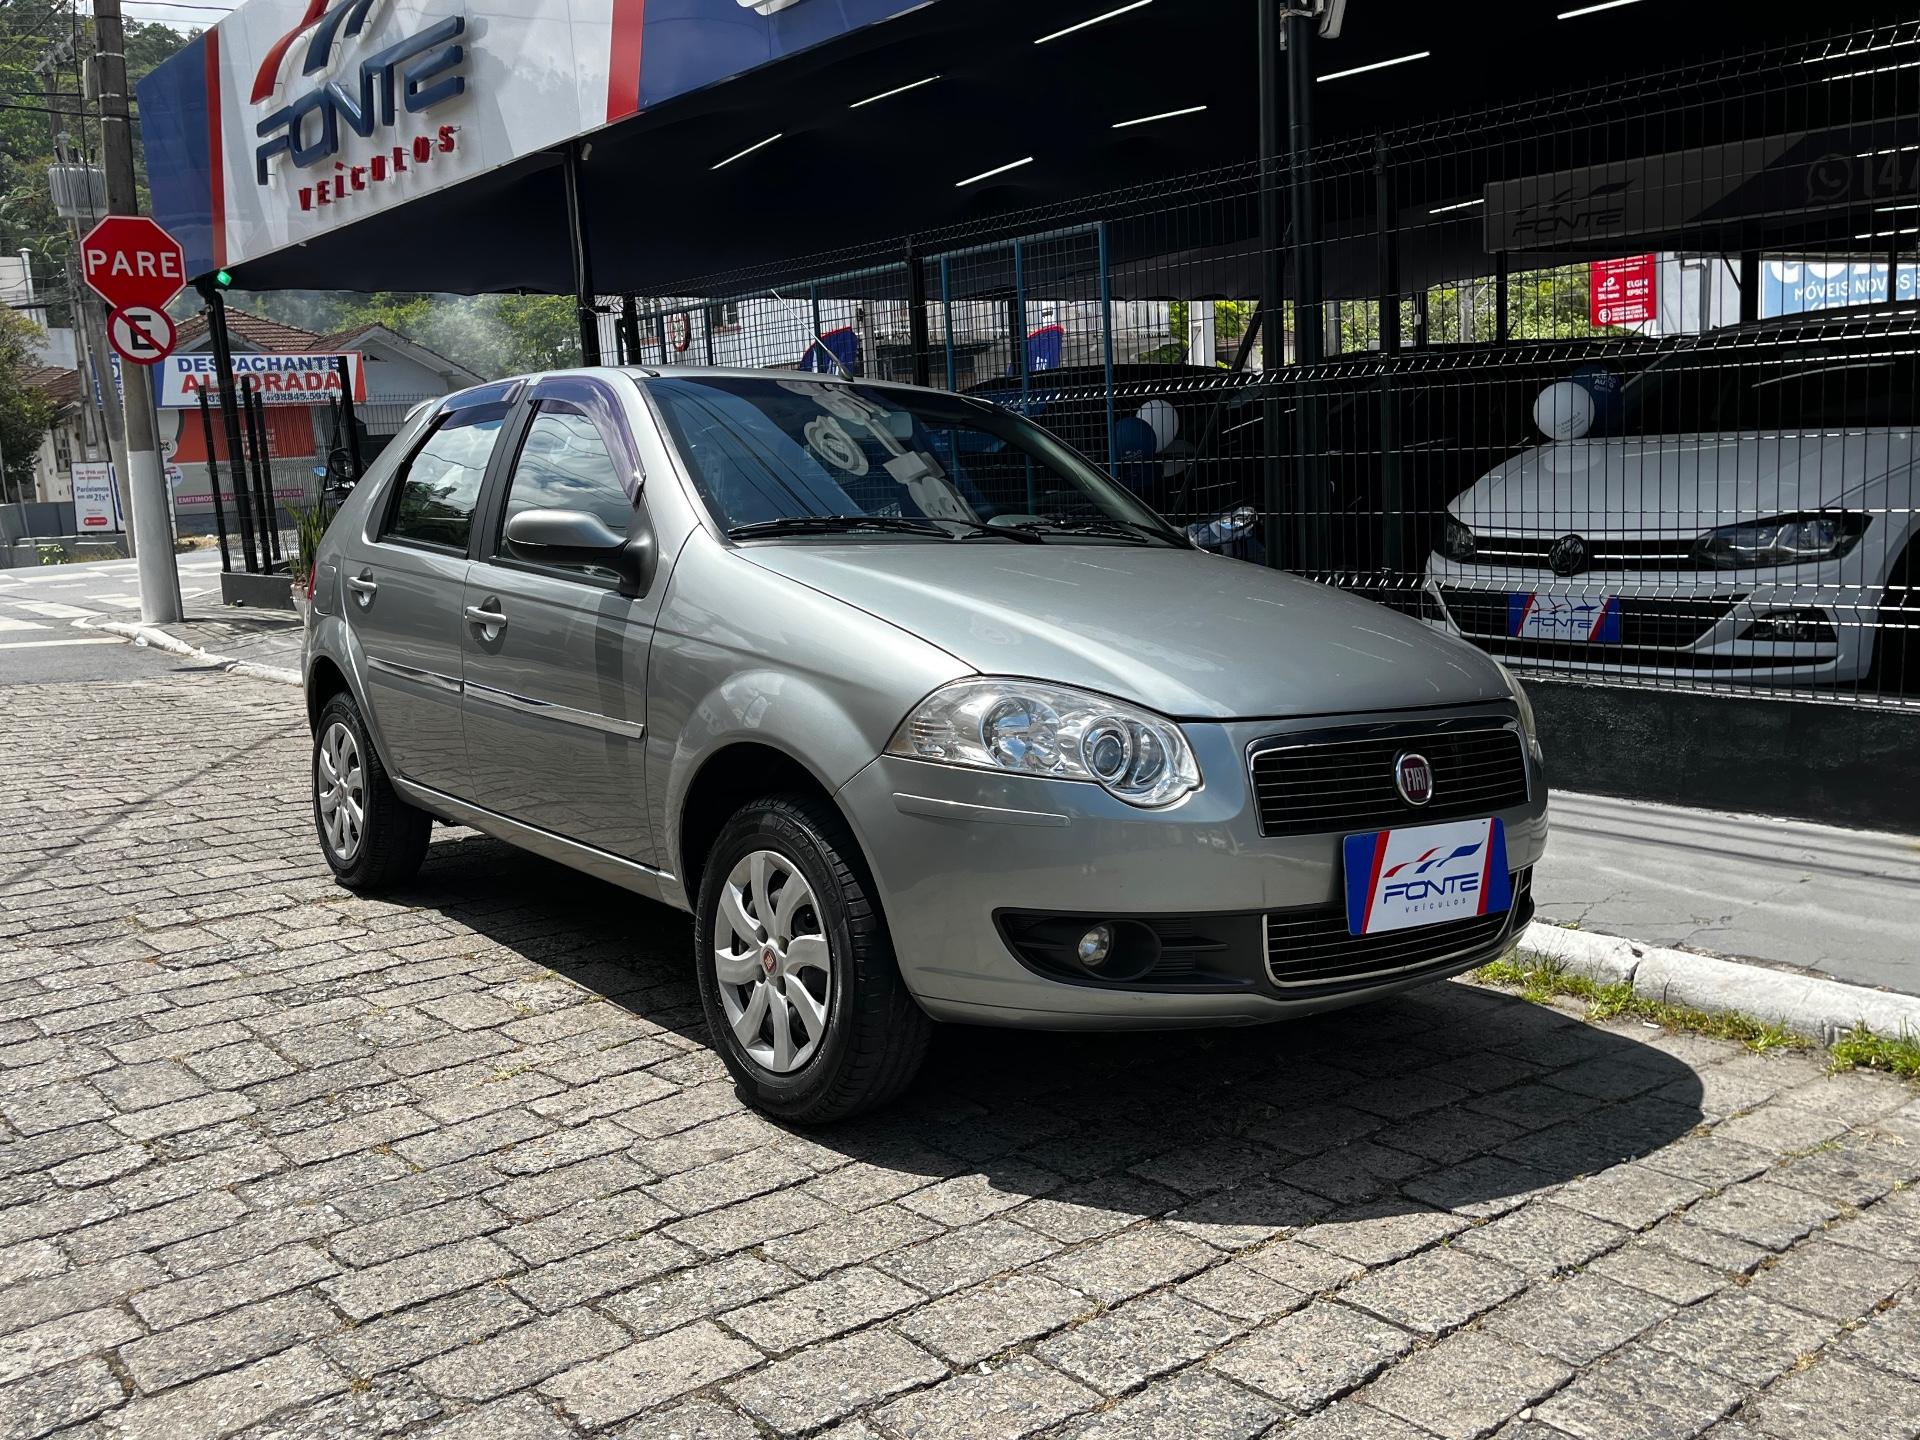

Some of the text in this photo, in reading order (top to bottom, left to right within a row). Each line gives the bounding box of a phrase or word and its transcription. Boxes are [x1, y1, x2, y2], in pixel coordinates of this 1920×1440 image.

[256, 15, 465, 186] FONTE
[298, 125, 455, 211] VEÍCULOS
[1512, 207, 1624, 237] FONTE
[87, 249, 180, 278] PARE
[1794, 280, 1851, 301] MÓVEIS
[1855, 273, 1911, 294] NOVS
[128, 315, 157, 350] E
[181, 371, 342, 394] ALORADA
[178, 494, 213, 504] EMITIMOS
[1529, 616, 1594, 629] FONTE
[1403, 766, 1427, 792] FIAT
[1383, 872, 1479, 904] FONTE
[1405, 897, 1466, 913] VEÍCULOS
